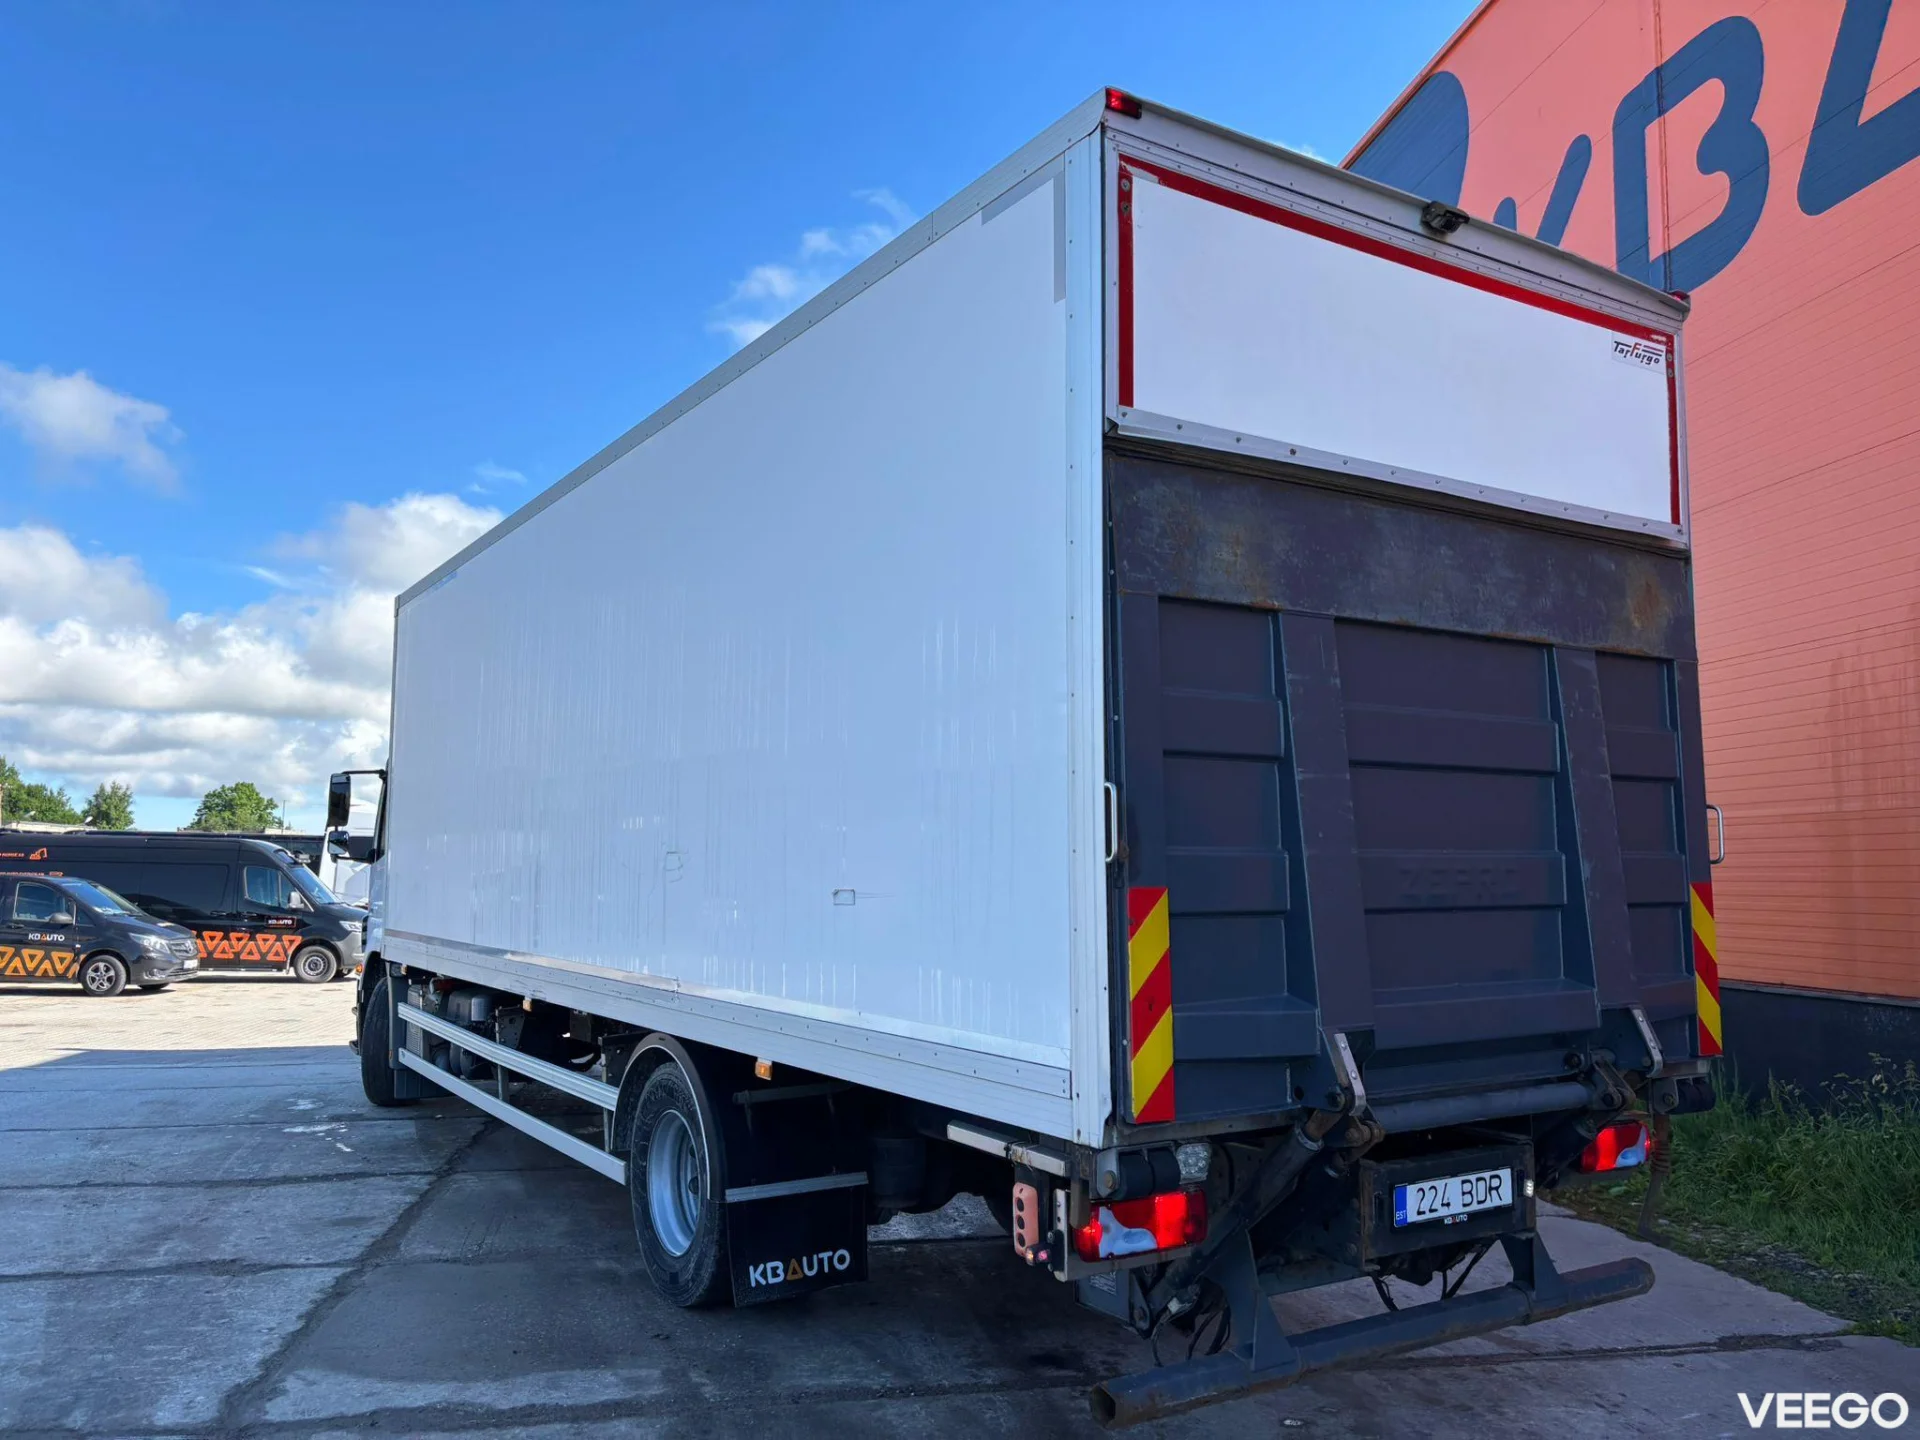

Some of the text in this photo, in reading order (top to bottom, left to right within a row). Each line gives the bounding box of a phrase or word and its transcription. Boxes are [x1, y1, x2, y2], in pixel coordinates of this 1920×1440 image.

[1614, 340, 1661, 365] TarFurgo
[1416, 1174, 1503, 1216] 224 BDR
[1395, 1210, 1407, 1221] EST
[749, 1248, 850, 1288] KBAUTO
